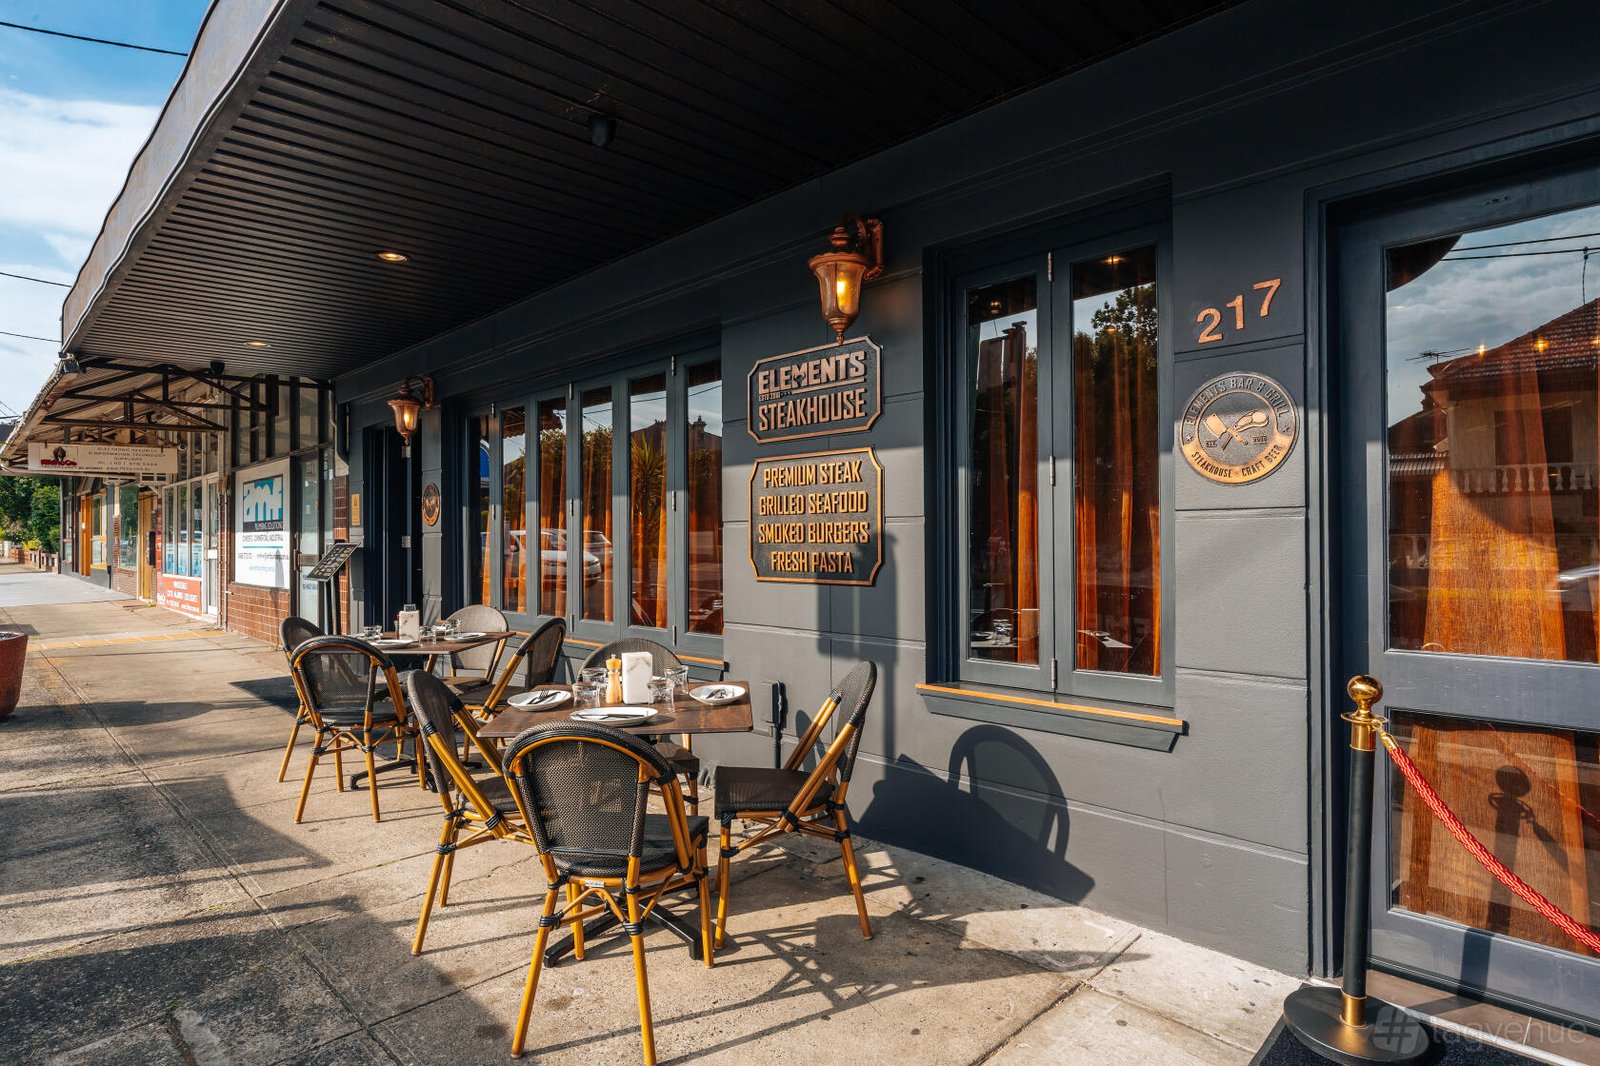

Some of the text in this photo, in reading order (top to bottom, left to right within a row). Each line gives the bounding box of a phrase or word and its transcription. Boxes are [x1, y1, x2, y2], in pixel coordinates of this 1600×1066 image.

[1196, 278, 1281, 344] 217
[758, 351, 865, 395] ELEMENTS
[758, 388, 866, 431] STEAKHOUSE
[1186, 381, 1227, 426] ELEMENTS
[1230, 377, 1253, 389] BAR
[1265, 387, 1290, 418] GRILL
[763, 460, 862, 489] PREMIUM STEAK
[1191, 444, 1282, 478] STEAKHOUSE CRAFT BEER
[759, 490, 867, 516] GRILLED SEAFOOD
[758, 522, 869, 544] SMOKED BURGERS
[771, 551, 853, 573] FRESH PASTA
